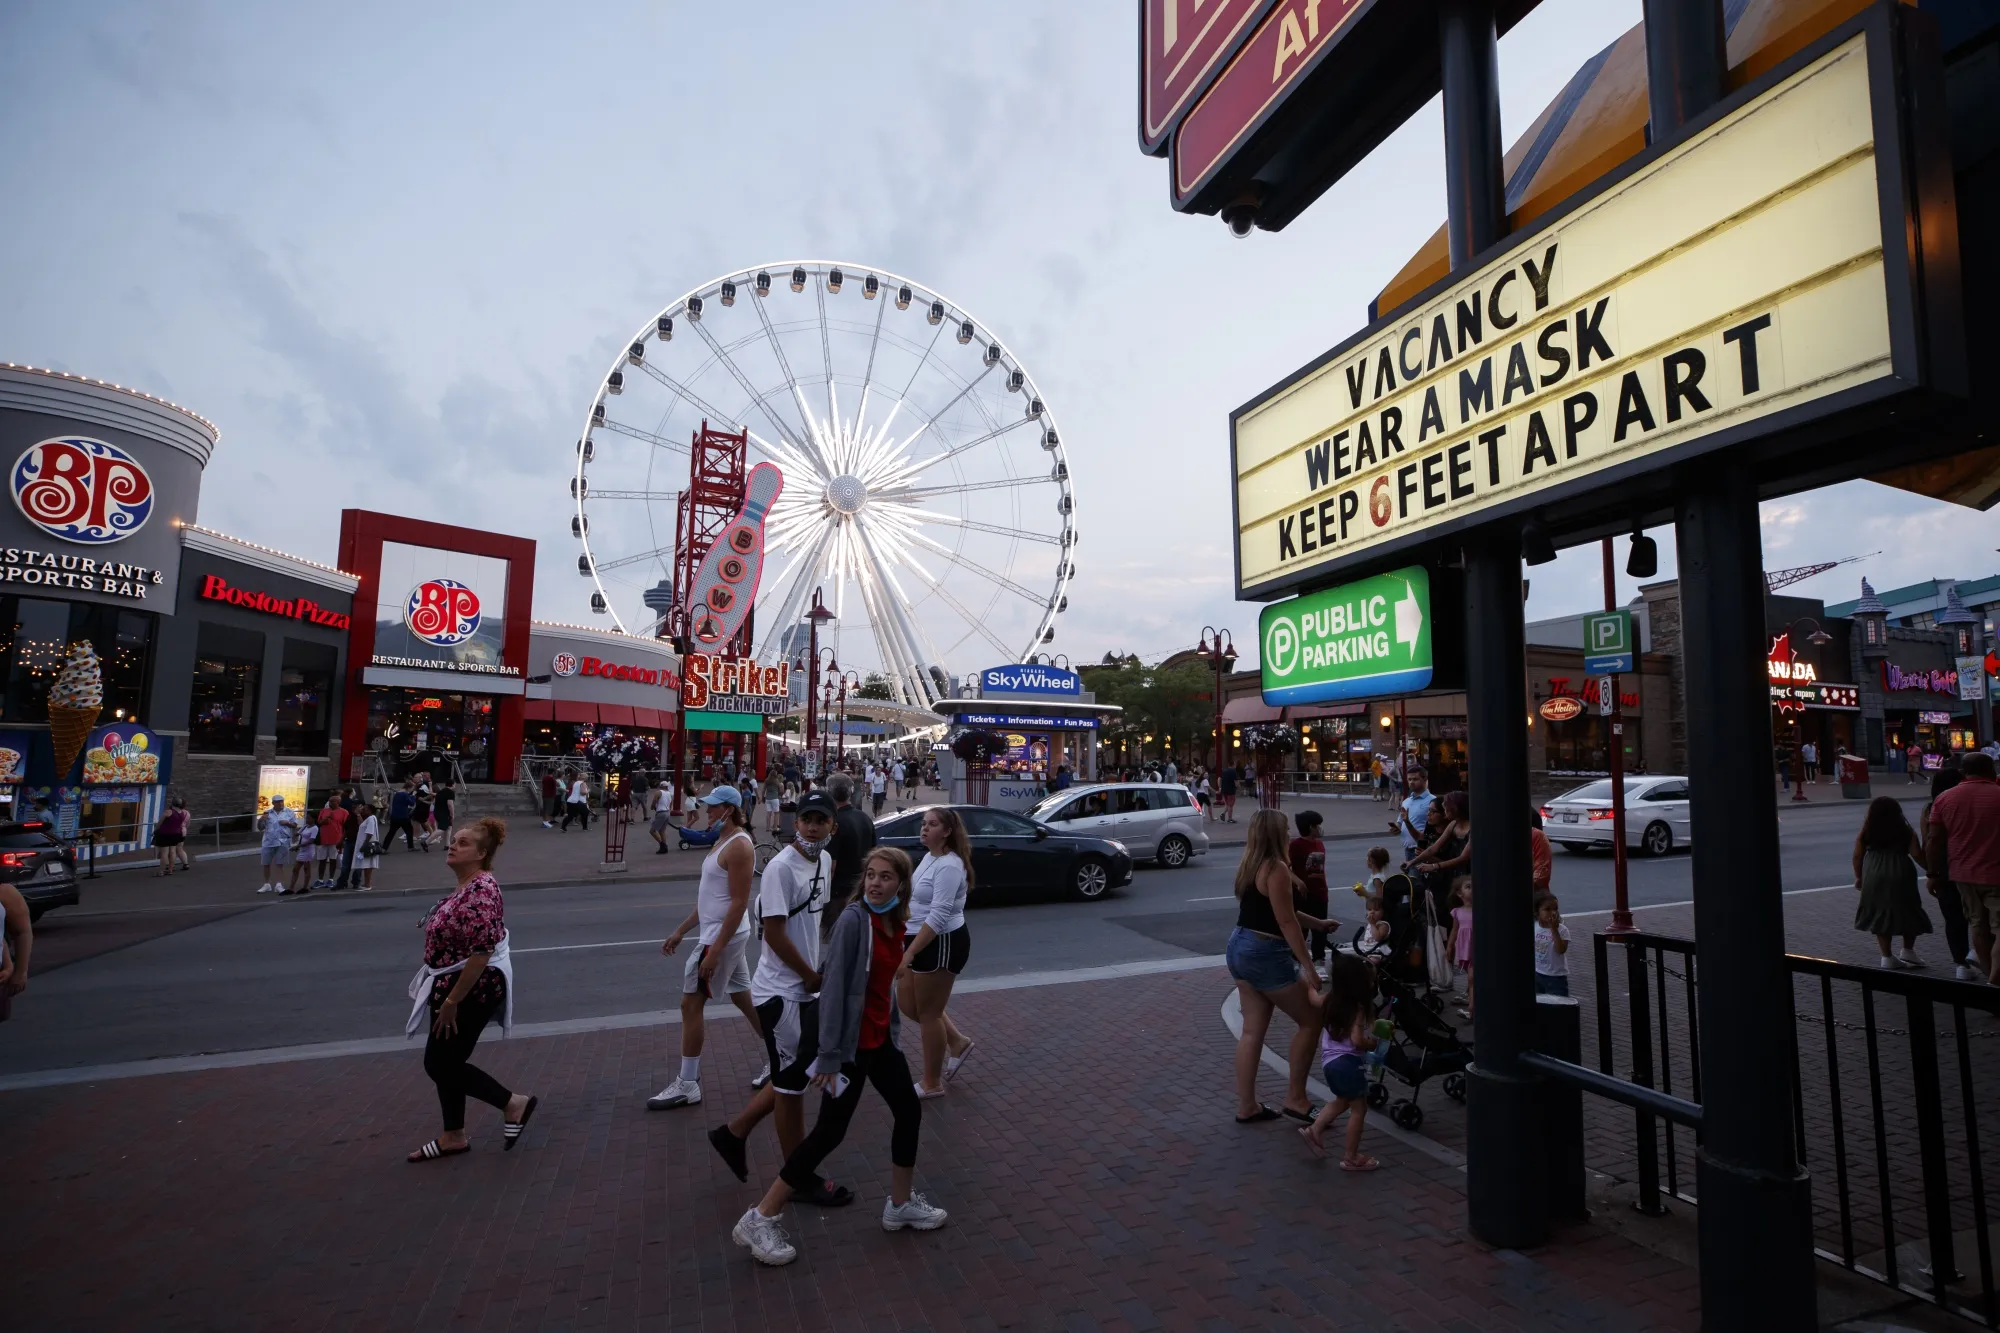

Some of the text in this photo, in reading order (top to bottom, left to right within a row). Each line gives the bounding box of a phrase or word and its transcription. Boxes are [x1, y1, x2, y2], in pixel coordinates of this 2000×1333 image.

[1346, 243, 1558, 409] VACANCY
[1305, 296, 1615, 491] WEAR A MASK
[1279, 313, 1771, 561] KEEP 6 FEET APART
[0, 547, 164, 584] STAURANT &
[103, 579, 147, 598] BAR
[202, 574, 350, 629] Boston Pizza
[1301, 595, 1386, 641] PUBLIC
[1599, 622, 1616, 645] P
[1302, 631, 1389, 669] PARKING
[372, 655, 520, 675] RESTAURANT & SPORTS BAR
[580, 656, 658, 685] Boston
[684, 653, 790, 708] Strike!
[988, 671, 1074, 689] SkyWheel
[1787, 687, 1816, 700] Cmpany
[423, 699, 442, 708] OPEN
[1541, 702, 1581, 714] Tim Hortons
[968, 715, 996, 724] Tickets
[1008, 716, 1053, 726] Information
